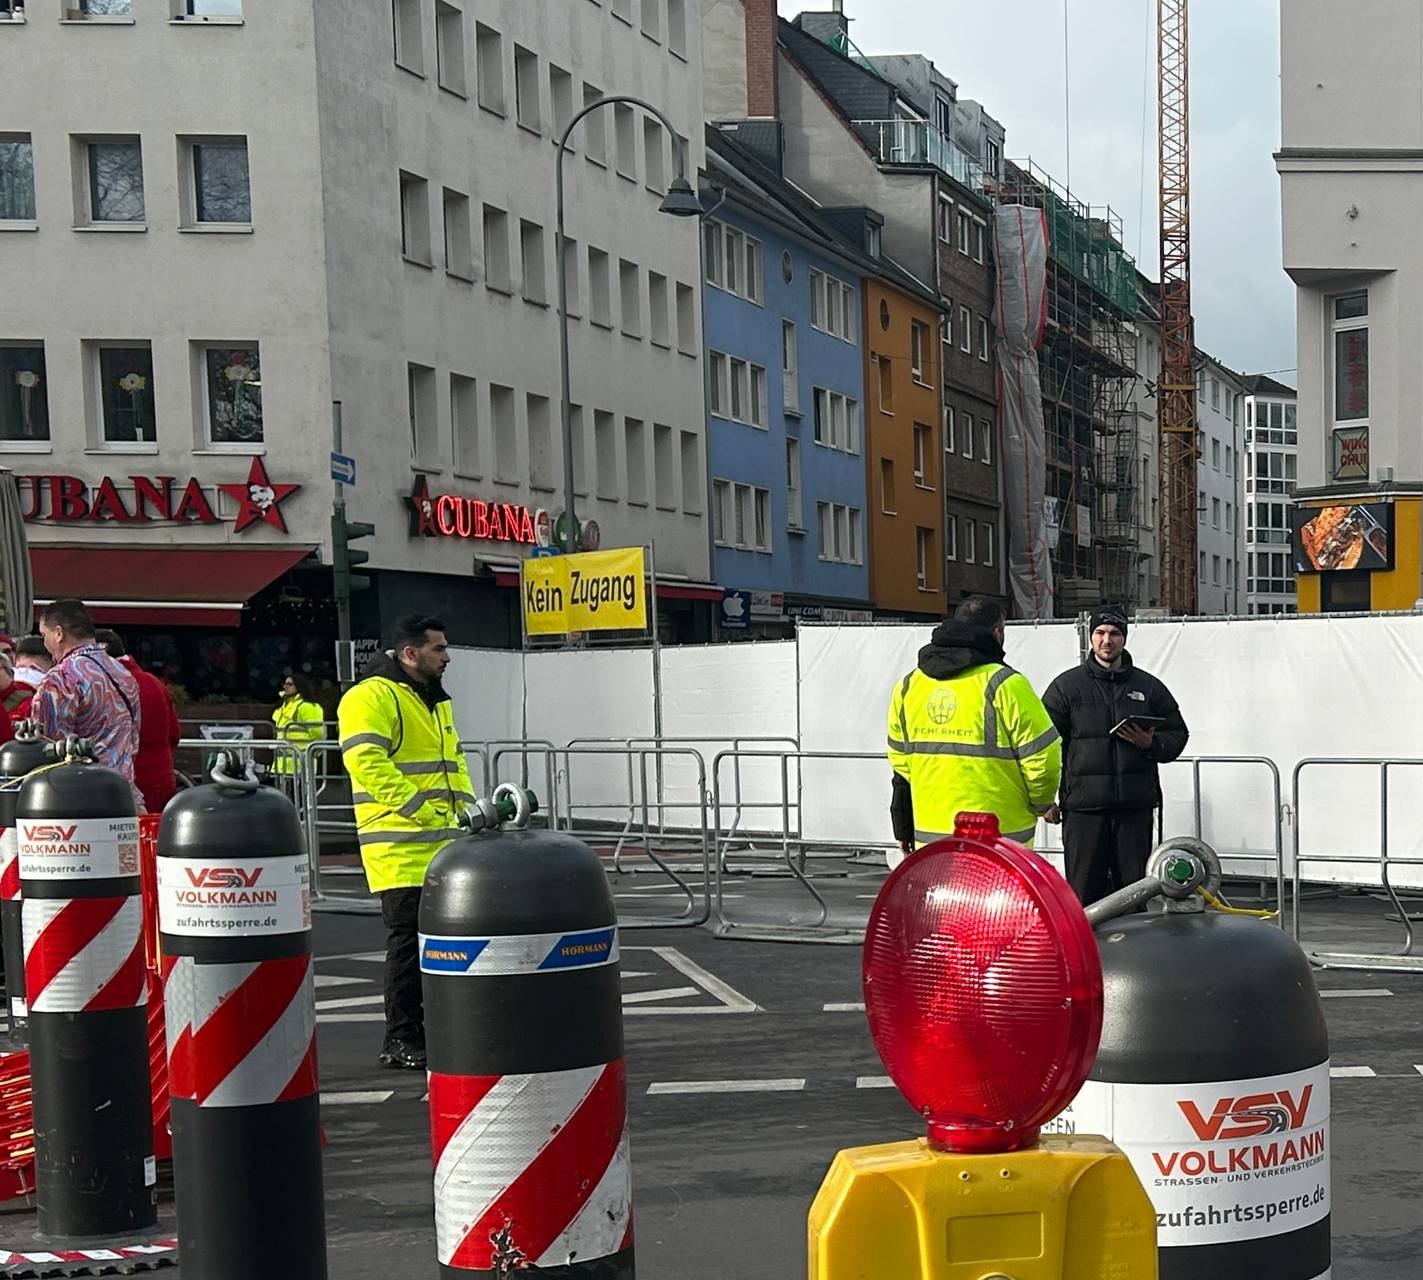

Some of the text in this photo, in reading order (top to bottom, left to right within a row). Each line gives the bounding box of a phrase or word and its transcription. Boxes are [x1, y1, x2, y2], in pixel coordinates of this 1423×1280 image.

[14, 476, 225, 521] UBANA
[437, 495, 536, 544] CUBANA
[526, 571, 635, 614] Kein Zugang
[20, 843, 91, 854] VOLKMANN
[23, 825, 78, 841] VSV
[184, 867, 263, 888] VSV
[176, 890, 278, 904] VOLKMANN
[177, 916, 278, 930] zufahrtssperre.de
[1176, 1084, 1314, 1141] VSV
[1152, 1128, 1325, 1177] VOLKMANN
[1154, 1177, 1223, 1187] STRASSEN-
[1227, 1173, 1251, 1183] UND
[1156, 1184, 1325, 1227] zufahrtssperre.de
